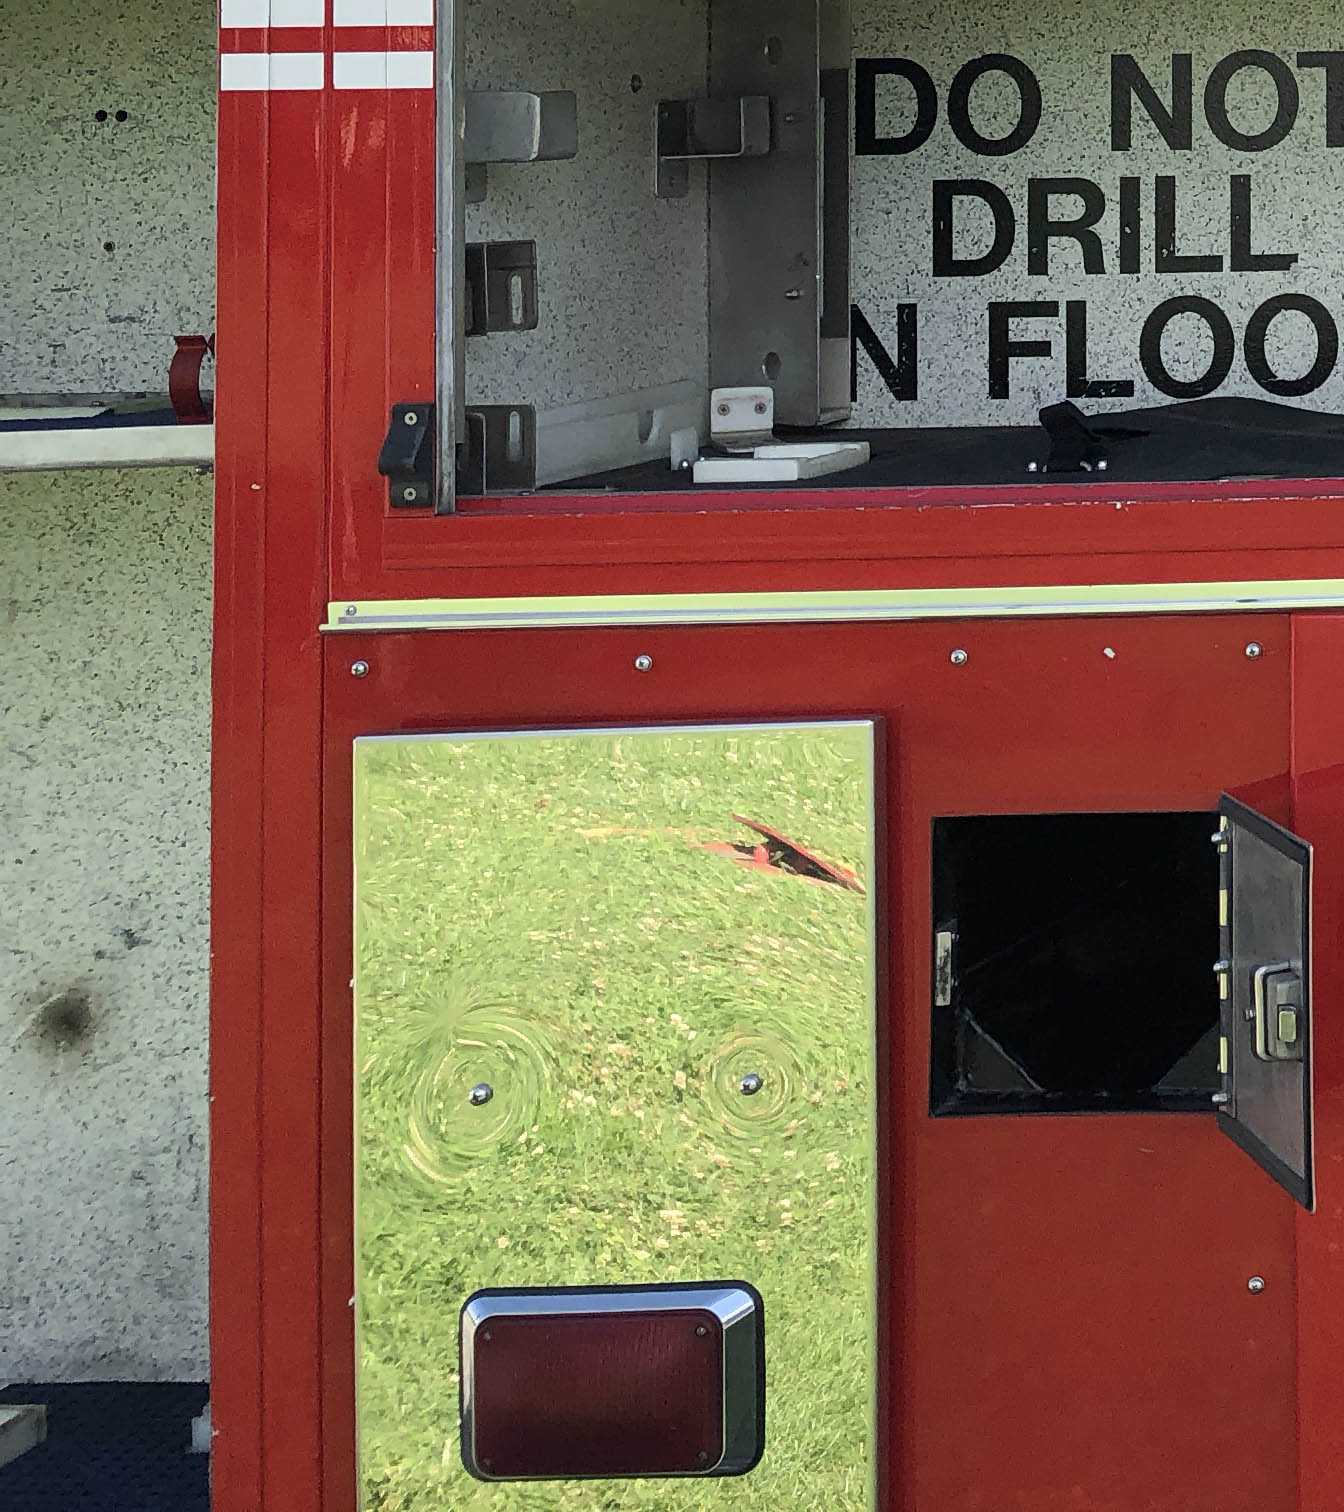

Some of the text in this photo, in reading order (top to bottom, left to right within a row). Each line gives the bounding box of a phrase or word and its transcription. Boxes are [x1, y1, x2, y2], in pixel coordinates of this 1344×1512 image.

[854, 53, 1043, 157] DO
[932, 174, 1299, 278] DRILL
[850, 301, 918, 402] N
